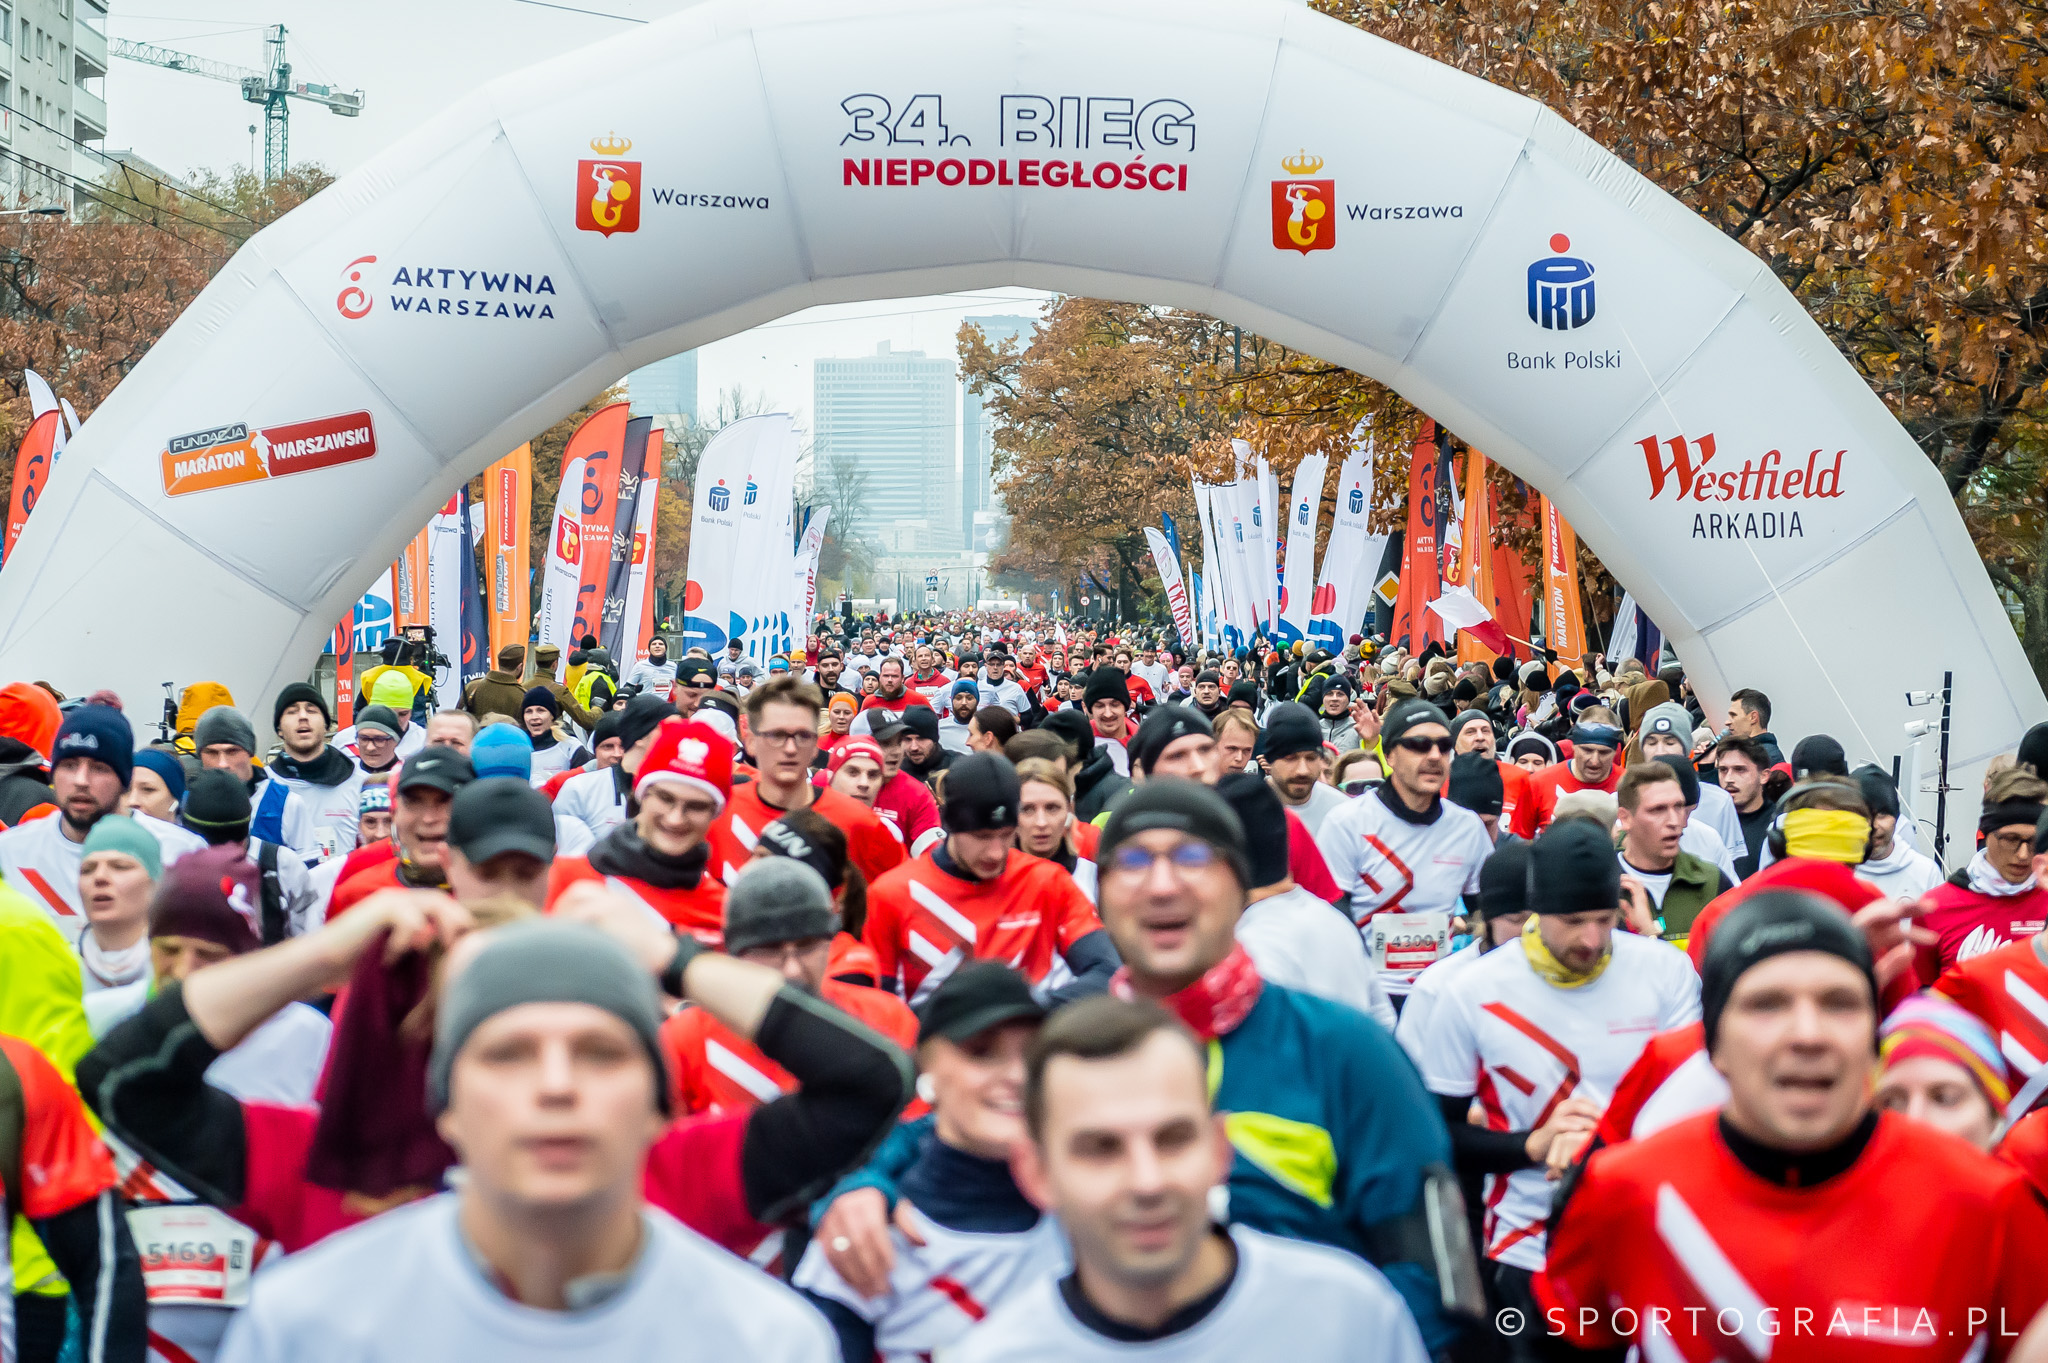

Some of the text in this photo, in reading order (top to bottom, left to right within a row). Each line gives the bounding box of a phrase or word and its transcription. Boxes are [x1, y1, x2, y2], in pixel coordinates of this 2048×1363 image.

[840, 93, 1196, 152] 34. BIEG
[843, 155, 1188, 191] NIEPODLEGŁOŚCI
[652, 187, 769, 210] Warszawa
[1346, 204, 1463, 221] Warszawa
[392, 266, 557, 295] AKTYWNA
[391, 295, 555, 319] WARSZAWA
[1507, 350, 1621, 369] Bank Polski
[173, 426, 245, 452] FUNDACJA
[174, 426, 370, 479] MARATON WARSZAWSKI
[1634, 433, 1848, 502] Westfield
[1692, 511, 1804, 539] ARKADIA
[1554, 587, 1568, 648] MARATON
[1392, 934, 1434, 948] 4300
[147, 1242, 216, 1263] 5169
